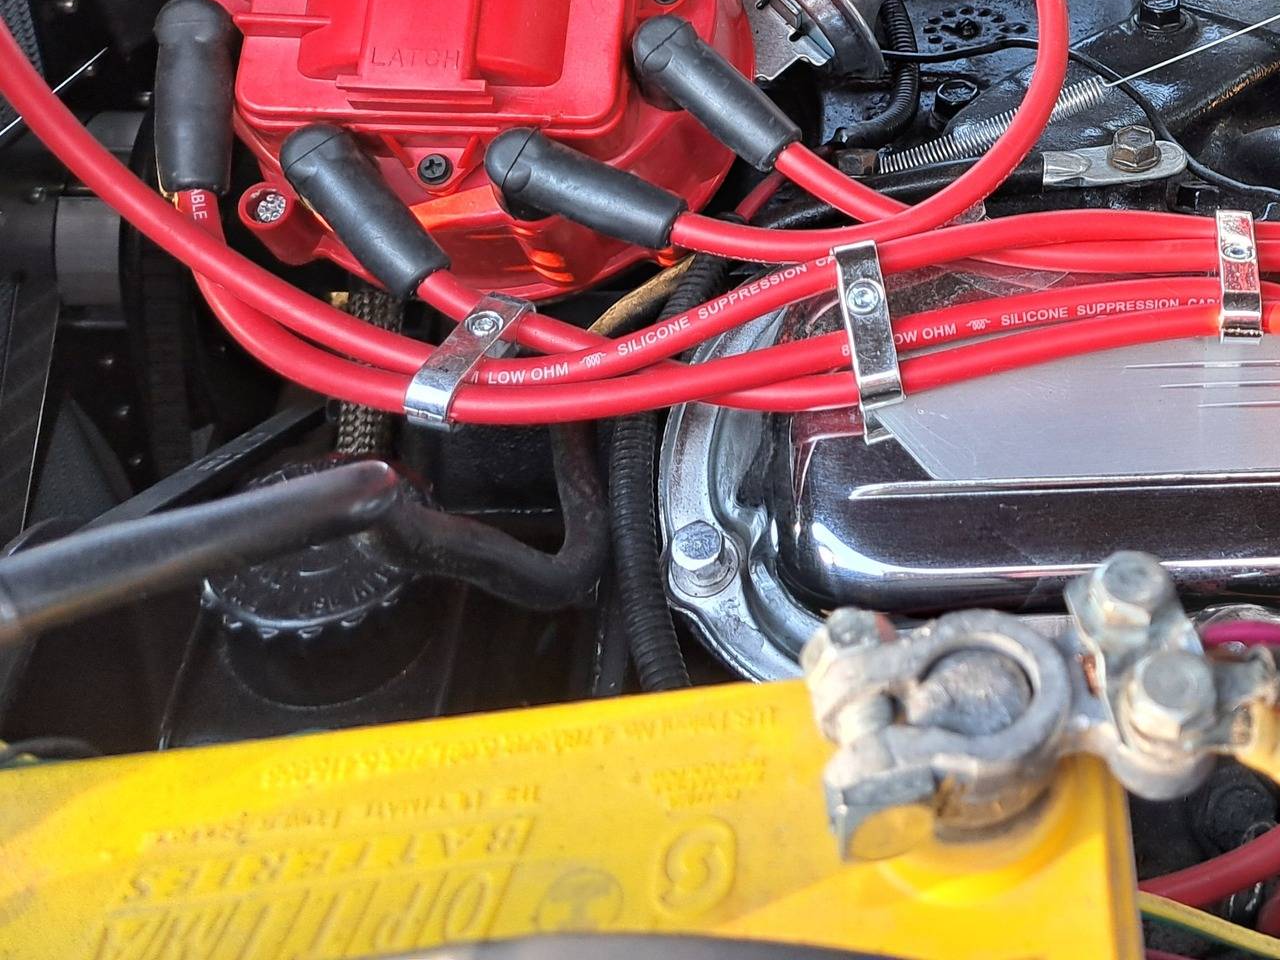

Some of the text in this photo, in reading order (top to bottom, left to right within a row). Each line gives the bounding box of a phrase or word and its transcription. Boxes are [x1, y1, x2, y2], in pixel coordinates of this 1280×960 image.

[371, 46, 460, 71] LATCH
[487, 263, 808, 386] LOW OHM SILICONE SUPPRESSION
[893, 330, 918, 345] OW
[922, 323, 957, 339] OHM
[1000, 305, 1069, 327] SILICONE
[1076, 297, 1180, 317] SUPPRESSION
[120, 822, 516, 902] BATTERIES
